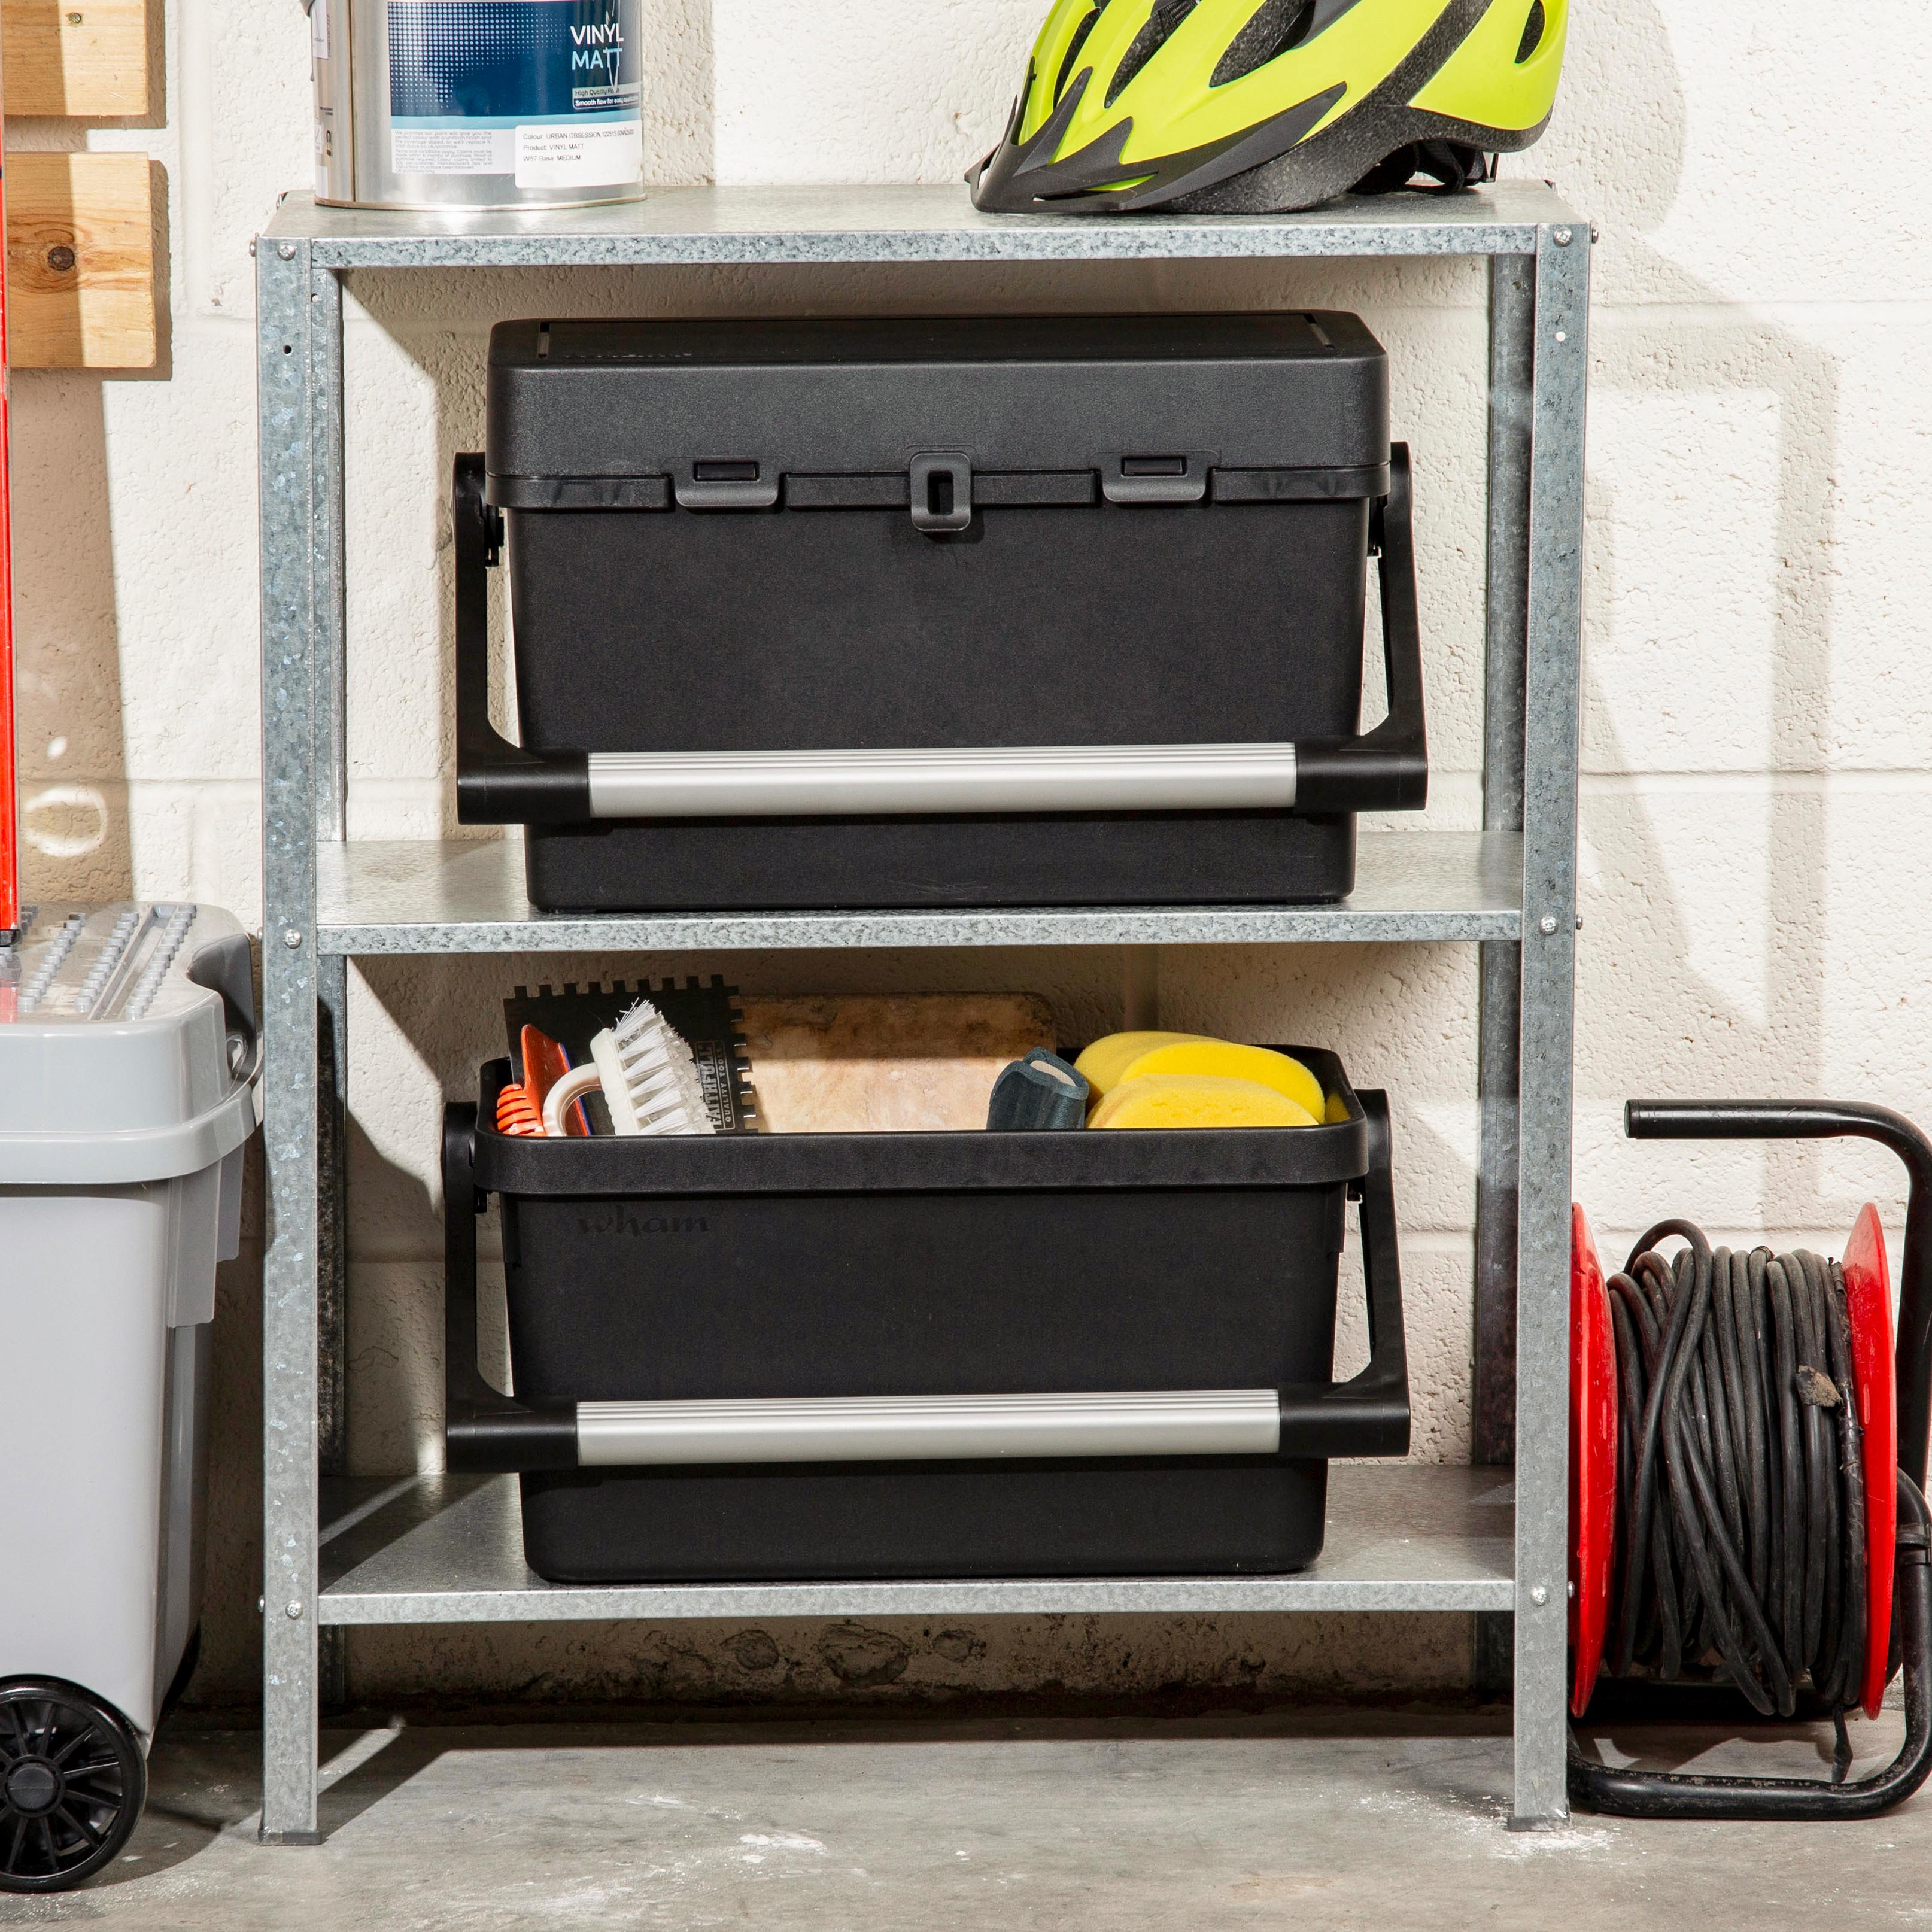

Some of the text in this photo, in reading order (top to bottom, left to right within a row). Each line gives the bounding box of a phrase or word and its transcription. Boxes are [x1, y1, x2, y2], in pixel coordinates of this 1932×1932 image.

[570, 23, 624, 45] VINYL
[572, 48, 622, 70] MATT
[720, 1082, 731, 1123] QUALITY
[576, 1204, 709, 1237] wham
